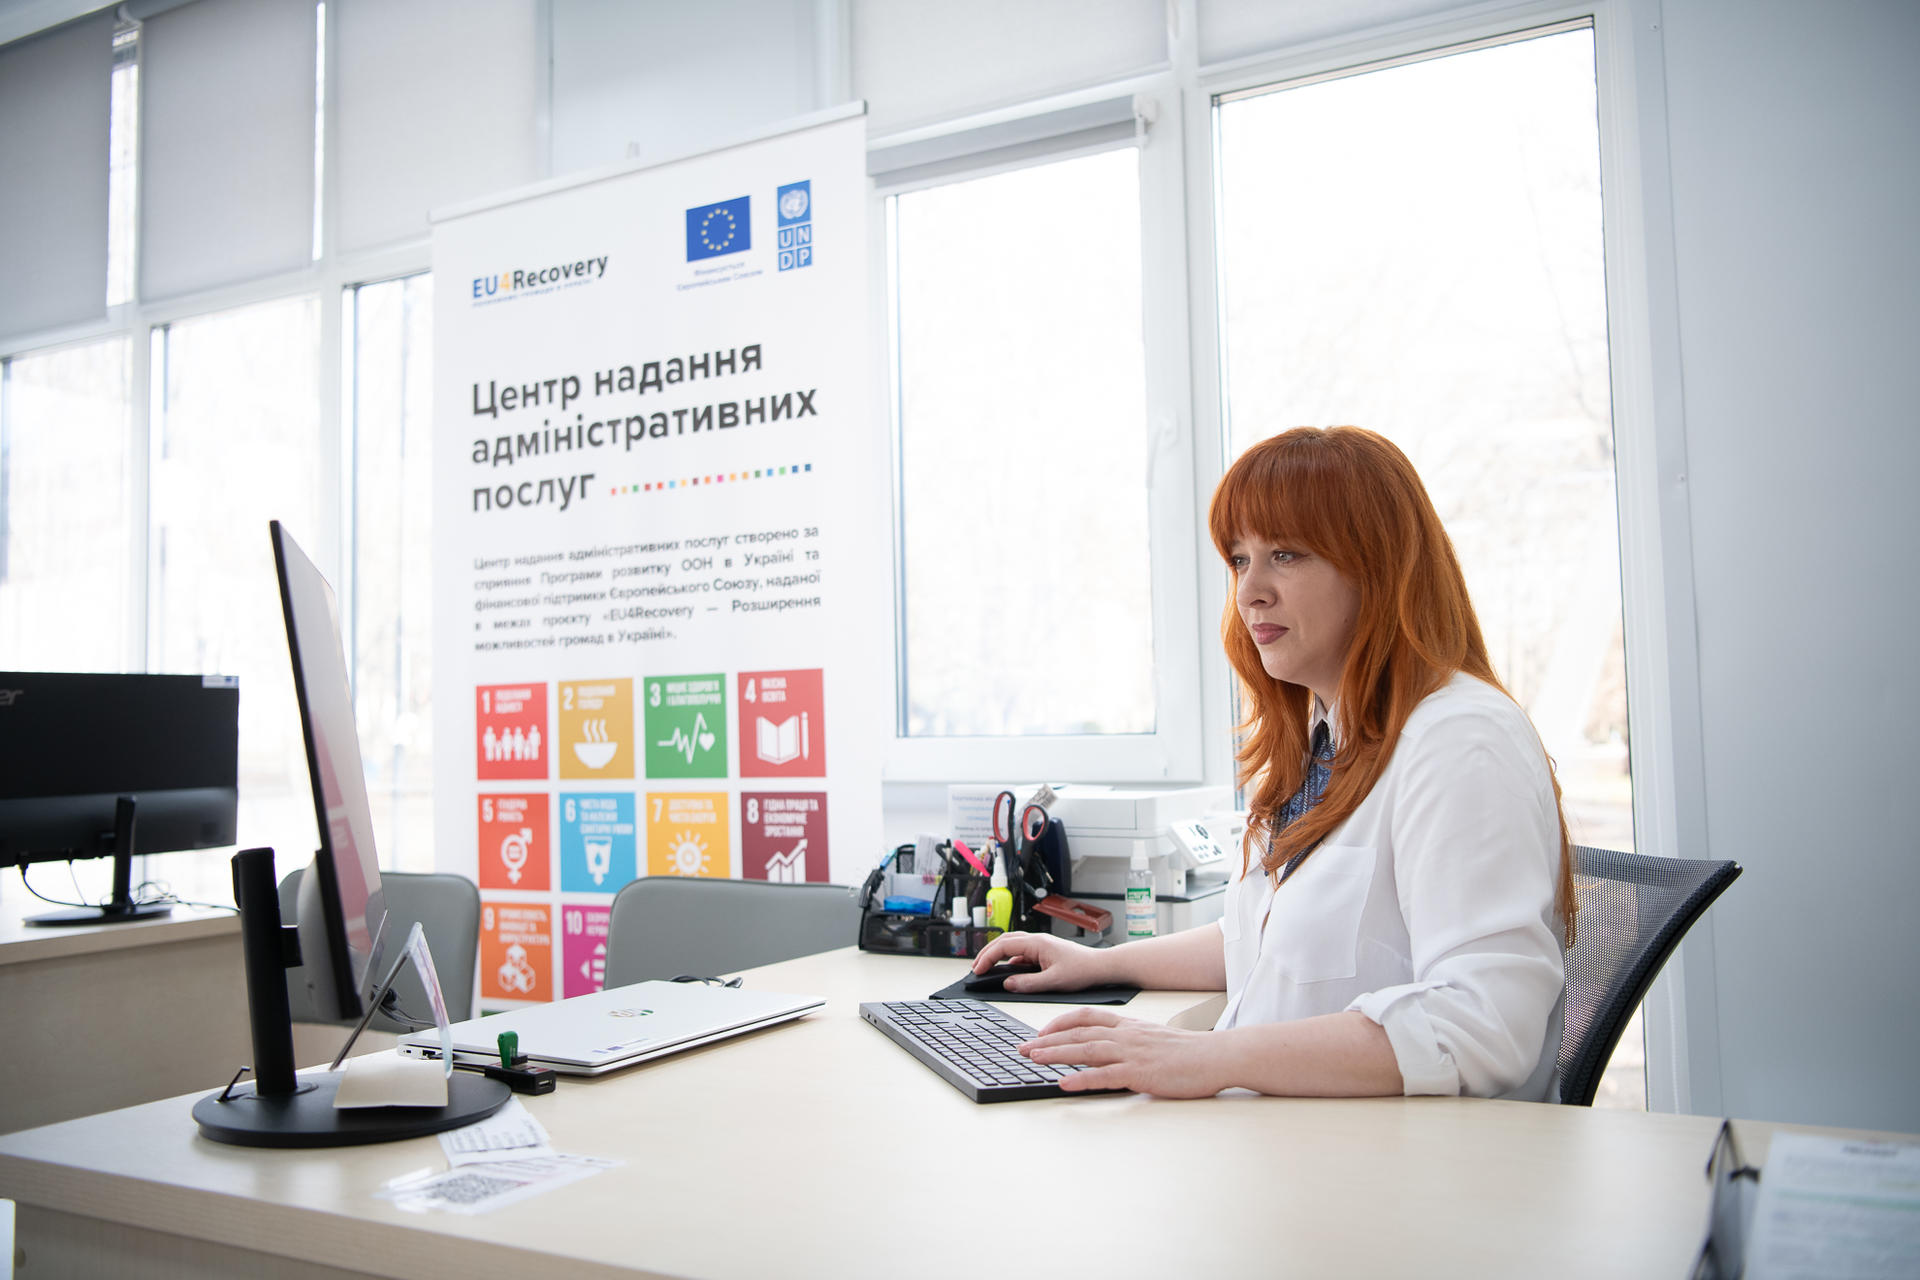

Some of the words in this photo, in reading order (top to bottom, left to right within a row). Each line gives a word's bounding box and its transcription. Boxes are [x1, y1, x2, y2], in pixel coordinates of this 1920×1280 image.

[473, 256, 608, 298] EU4Recovery
[473, 373, 581, 419] Центр
[595, 343, 763, 395] надання
[472, 389, 818, 467] адміністративних
[473, 473, 596, 512] послуг
[474, 557, 510, 571] Центр
[514, 551, 564, 567] надання
[569, 541, 680, 560] адміністративних
[685, 535, 729, 551] послуг
[735, 528, 799, 545] створено
[803, 526, 819, 538] за
[540, 570, 602, 585] Програми
[612, 563, 671, 581] розвитку
[681, 556, 713, 572] ООН
[725, 559, 733, 568] в
[744, 548, 794, 568] Україні
[805, 549, 819, 561] та
[475, 593, 539, 612] фінансової
[544, 589, 606, 606] підтримки
[610, 582, 710, 600] Європейського
[713, 577, 763, 592] Союзу,
[766, 570, 821, 587] наданої
[732, 596, 821, 613] Розширення
[475, 635, 555, 651] можливостей
[558, 632, 604, 648] громад
[482, 690, 490, 714] 1
[563, 687, 573, 711] 2
[650, 682, 661, 707] 3
[744, 678, 756, 704] 4
[482, 799, 493, 823] 5
[565, 799, 576, 823] 6
[652, 798, 663, 823] 7
[747, 798, 759, 824] 8
[484, 906, 494, 931] 9
[565, 910, 583, 935] 10
